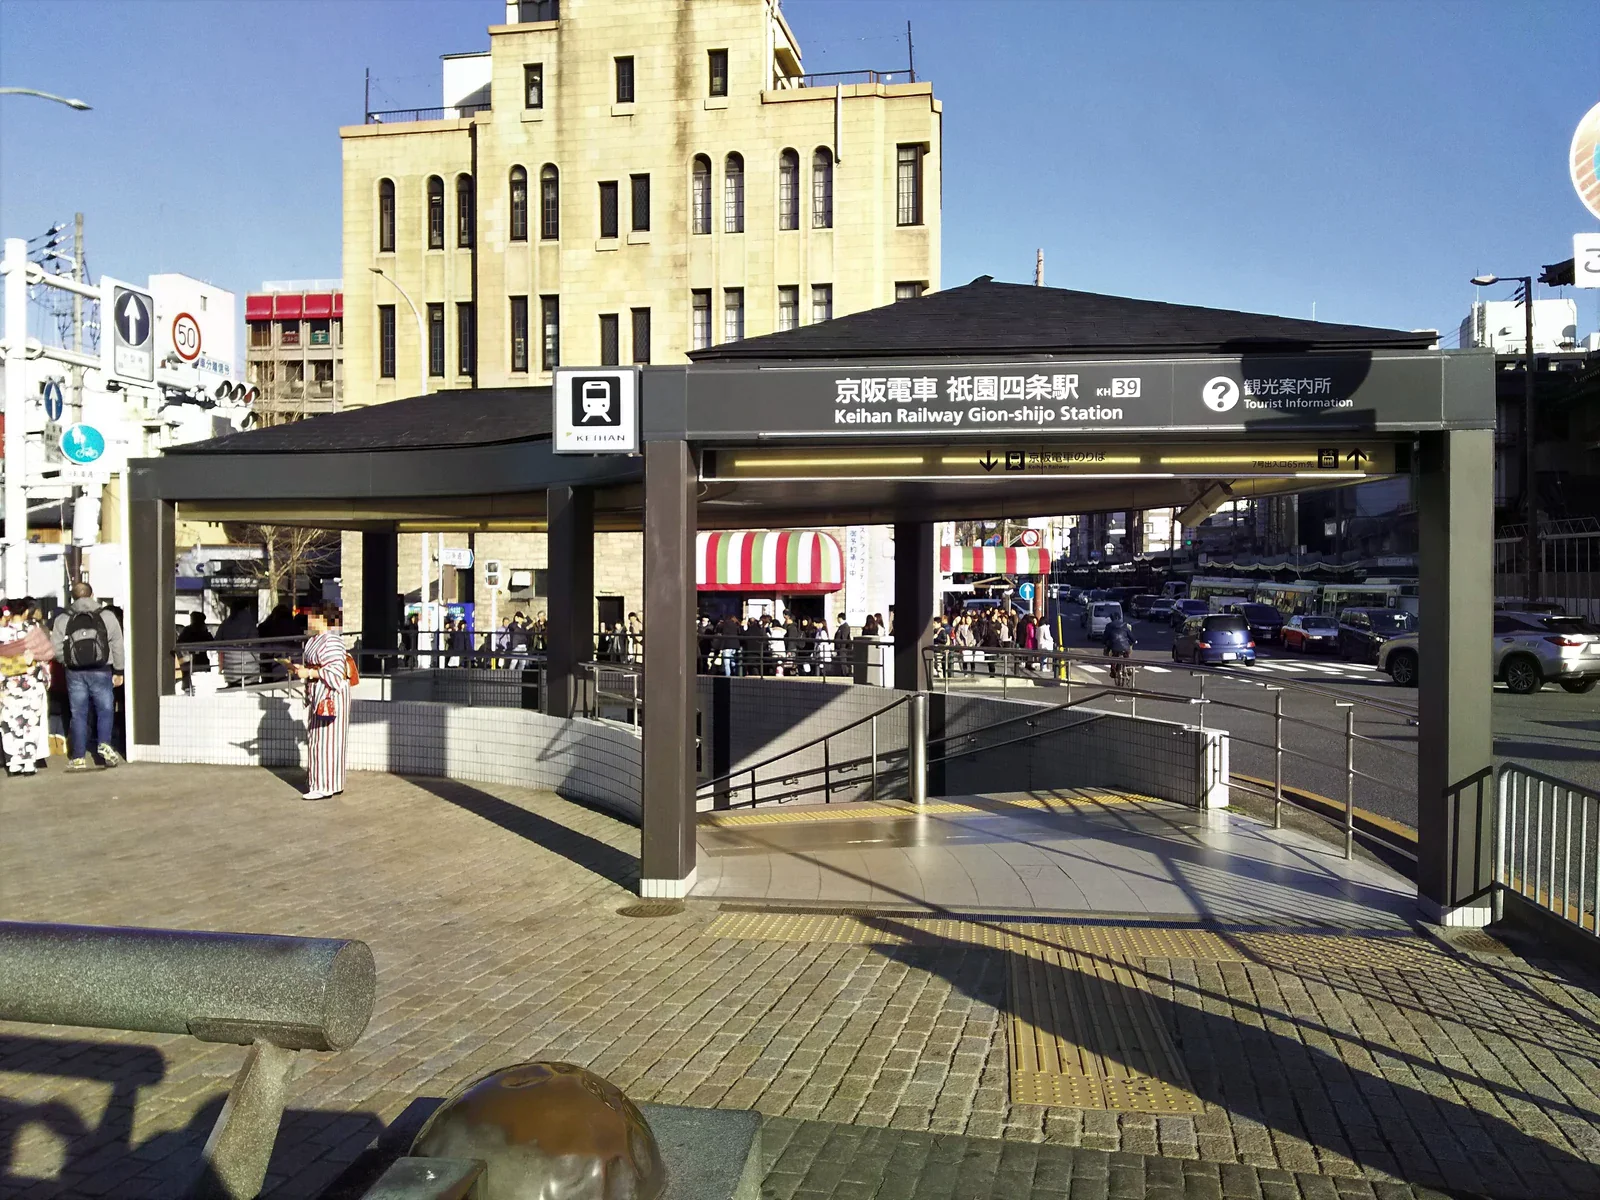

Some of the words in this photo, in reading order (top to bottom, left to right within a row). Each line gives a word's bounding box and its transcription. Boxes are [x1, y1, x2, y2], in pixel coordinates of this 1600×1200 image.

[178, 323, 195, 348] 50
[835, 376, 938, 404] 京阪電車
[946, 374, 1079, 402] 祇園四条駅
[1243, 377, 1332, 396] 観光案内所
[1244, 398, 1283, 409] Tourist
[1286, 397, 1354, 408] Information
[834, 408, 892, 424] Keihan
[897, 407, 963, 425] Railway
[968, 406, 1055, 425] Gion-shijo
[1060, 406, 1123, 421] Station
[576, 434, 625, 442] KEIHAN
[1028, 451, 1107, 463] 京阪電車のりば
[1251, 460, 1314, 469] 7号出入口65m先
